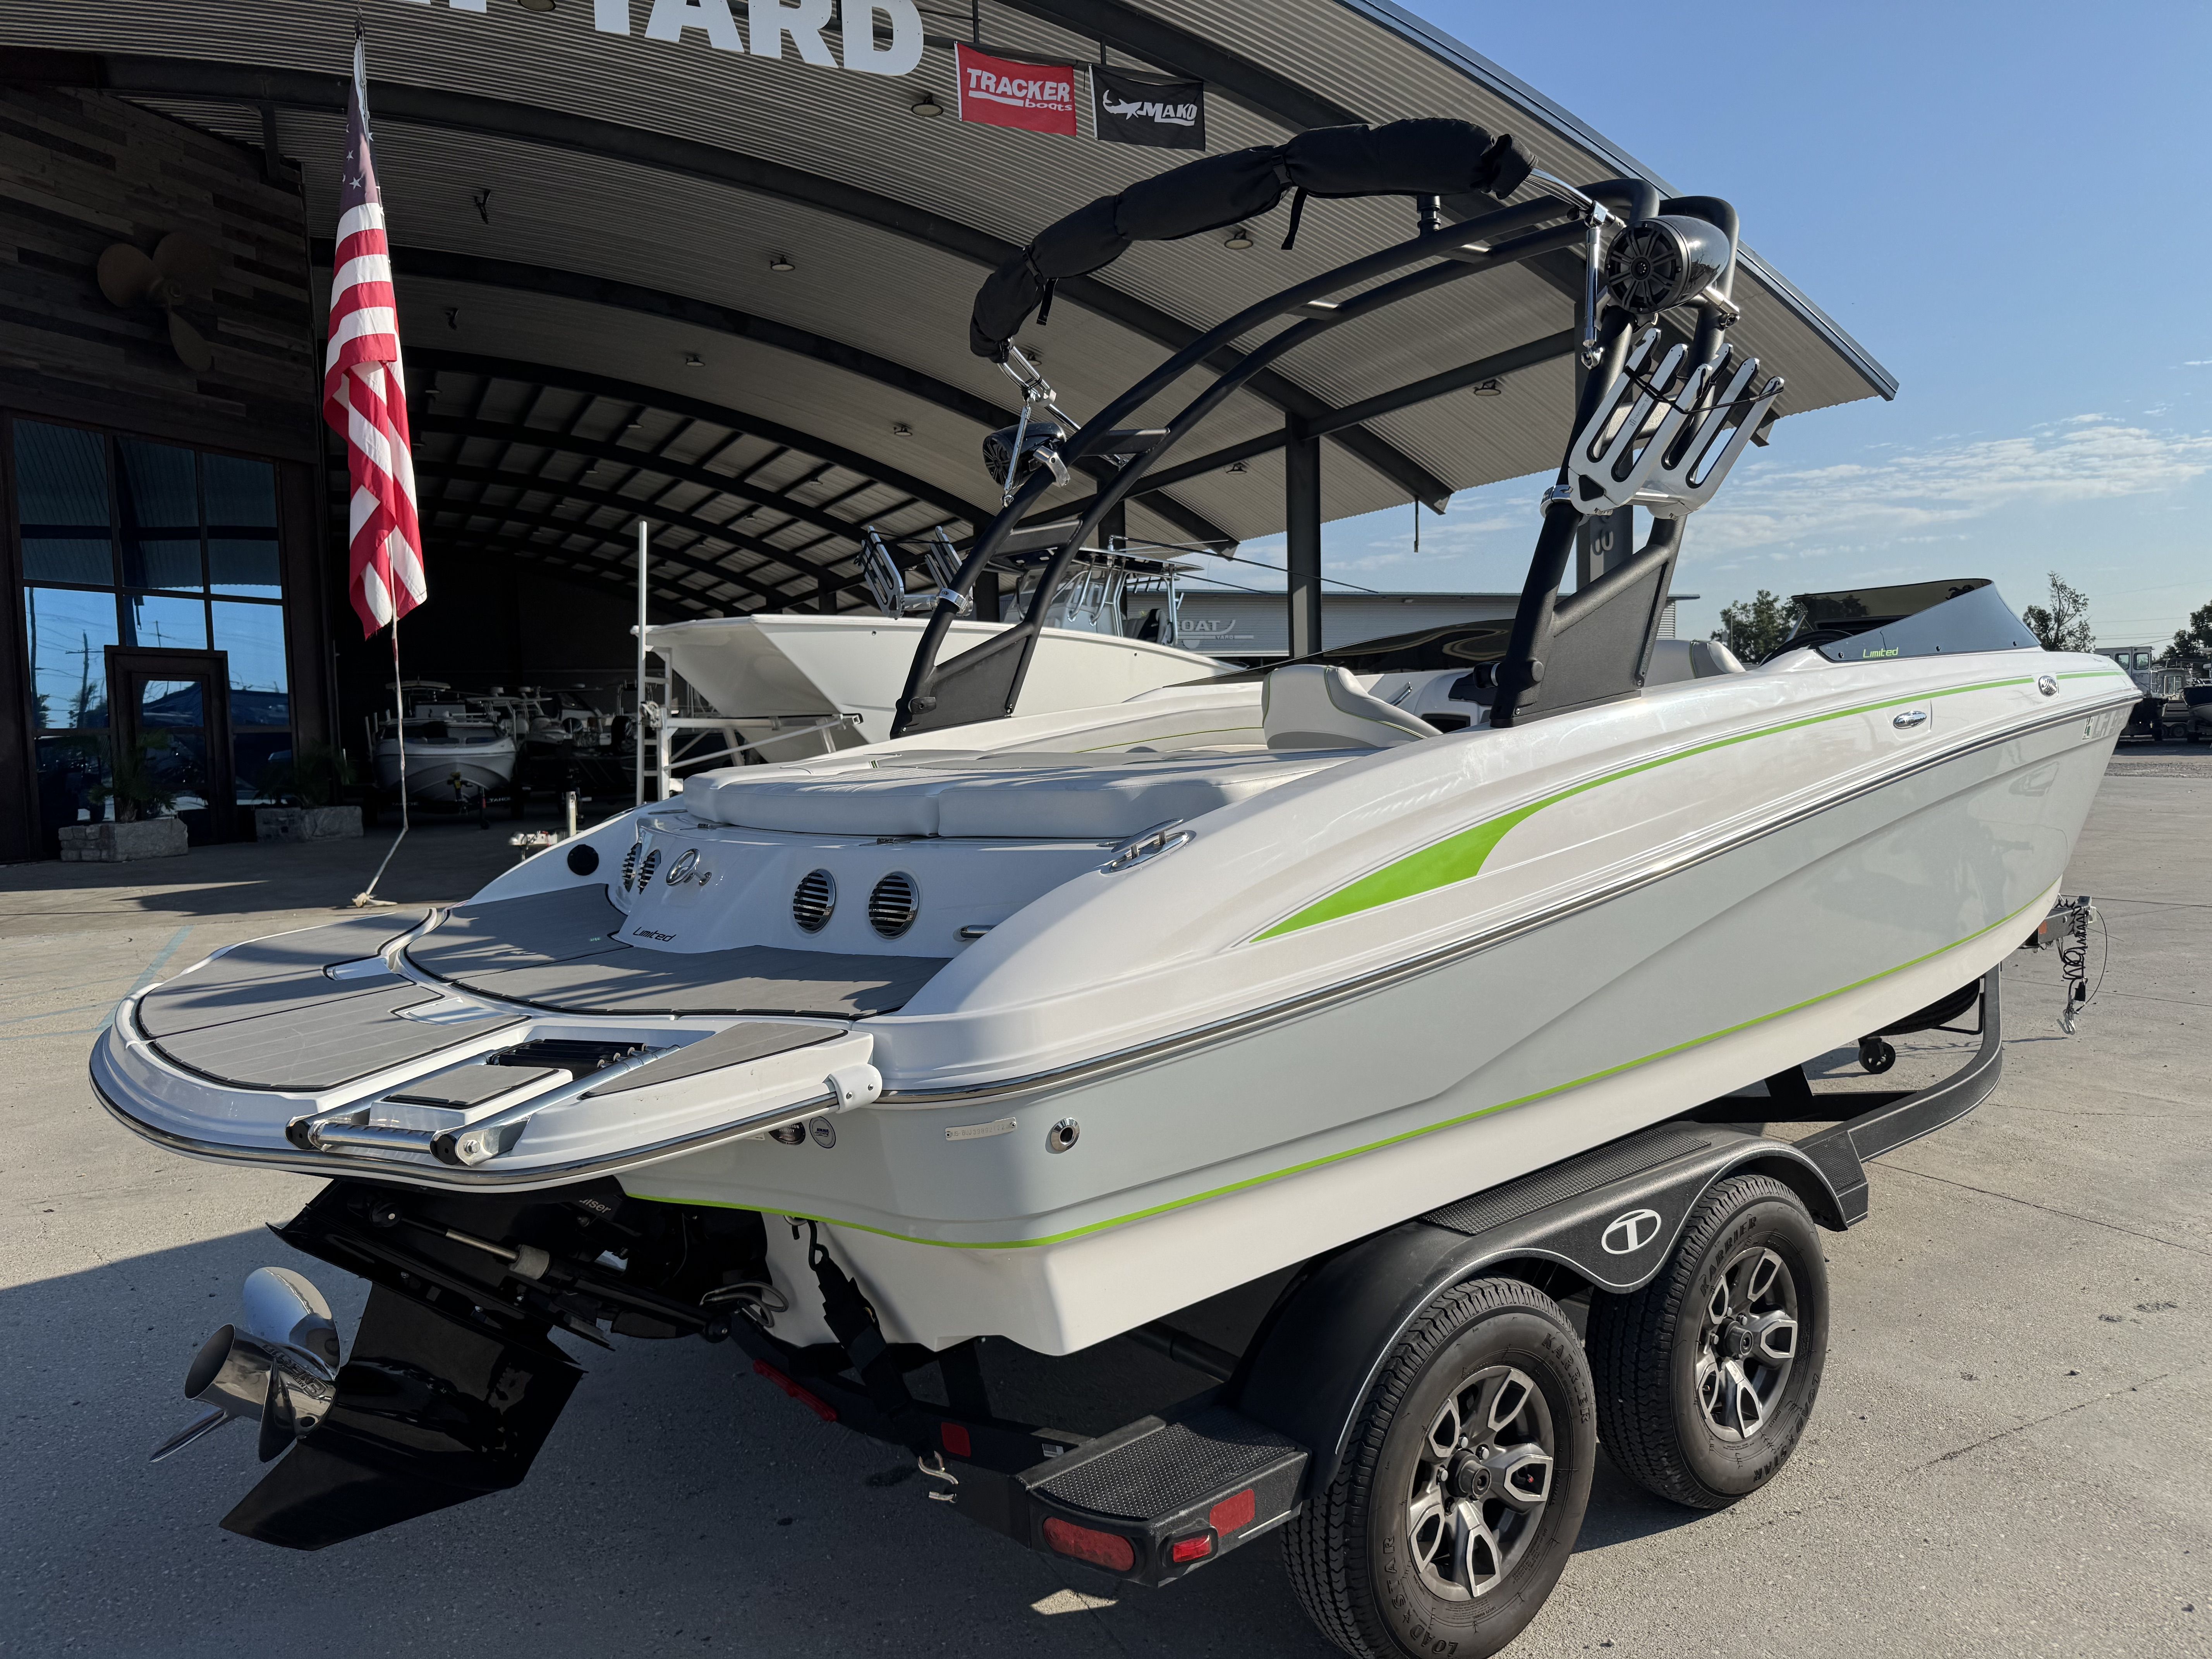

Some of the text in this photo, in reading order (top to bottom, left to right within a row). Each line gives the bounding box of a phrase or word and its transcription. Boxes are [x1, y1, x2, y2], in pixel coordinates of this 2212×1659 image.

[967, 68, 1071, 102] TRACKER
[1024, 98, 1072, 112] boats
[1138, 102, 1198, 126] MAKO
[1178, 620, 1220, 631] OAT
[1863, 647, 1898, 658] Limited
[633, 926, 677, 942] Limited
[1700, 1216, 1757, 1297] KARRIER
[1542, 1333, 1590, 1424] KARRIER
[1383, 1536, 1459, 1659] LOAD STAR
